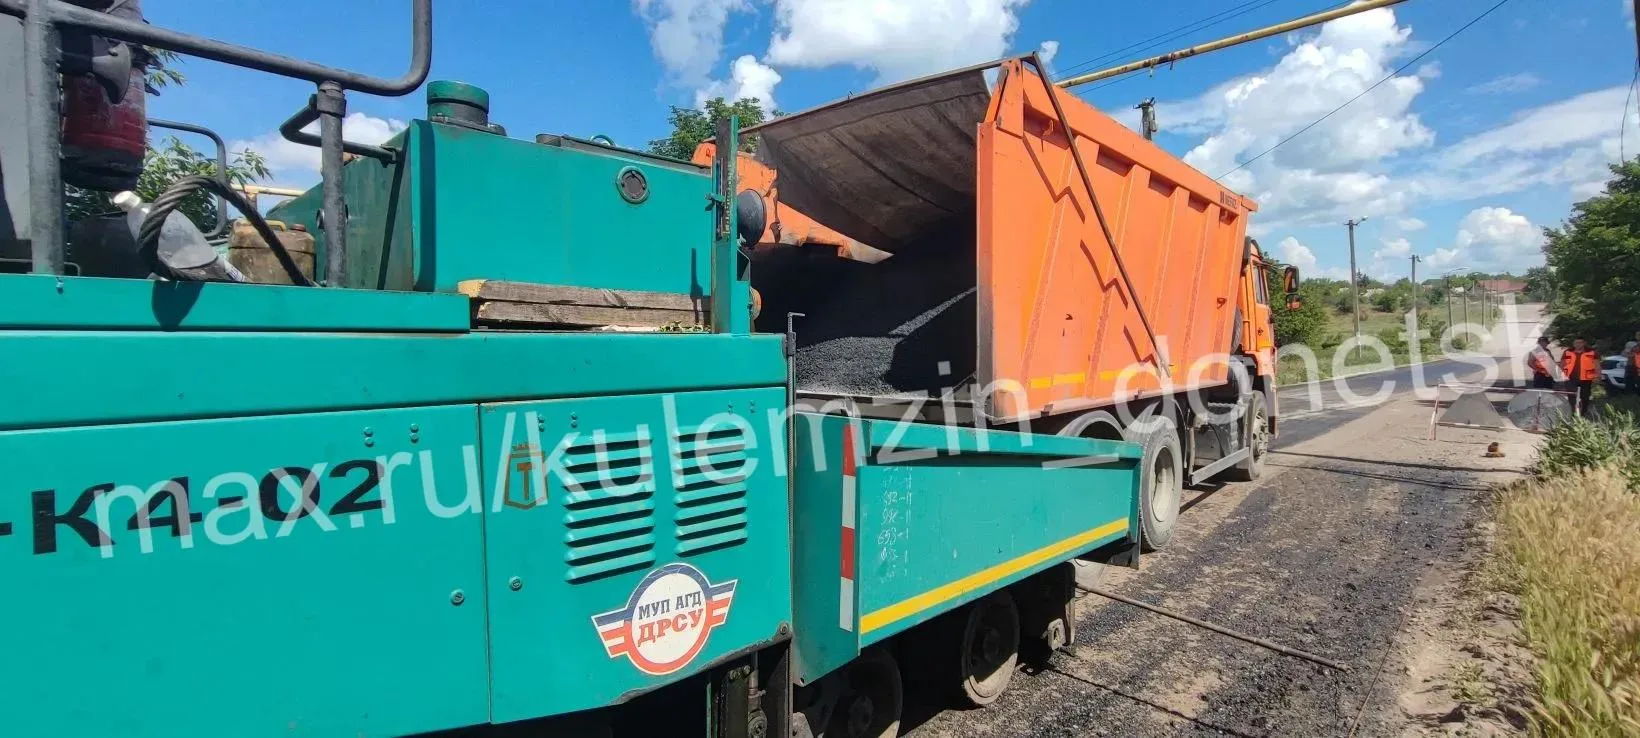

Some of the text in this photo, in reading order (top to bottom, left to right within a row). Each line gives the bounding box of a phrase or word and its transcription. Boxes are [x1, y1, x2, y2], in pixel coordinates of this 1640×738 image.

[638, 591, 702, 620] МУП АГД
[638, 609, 703, 647] ДРСУ
